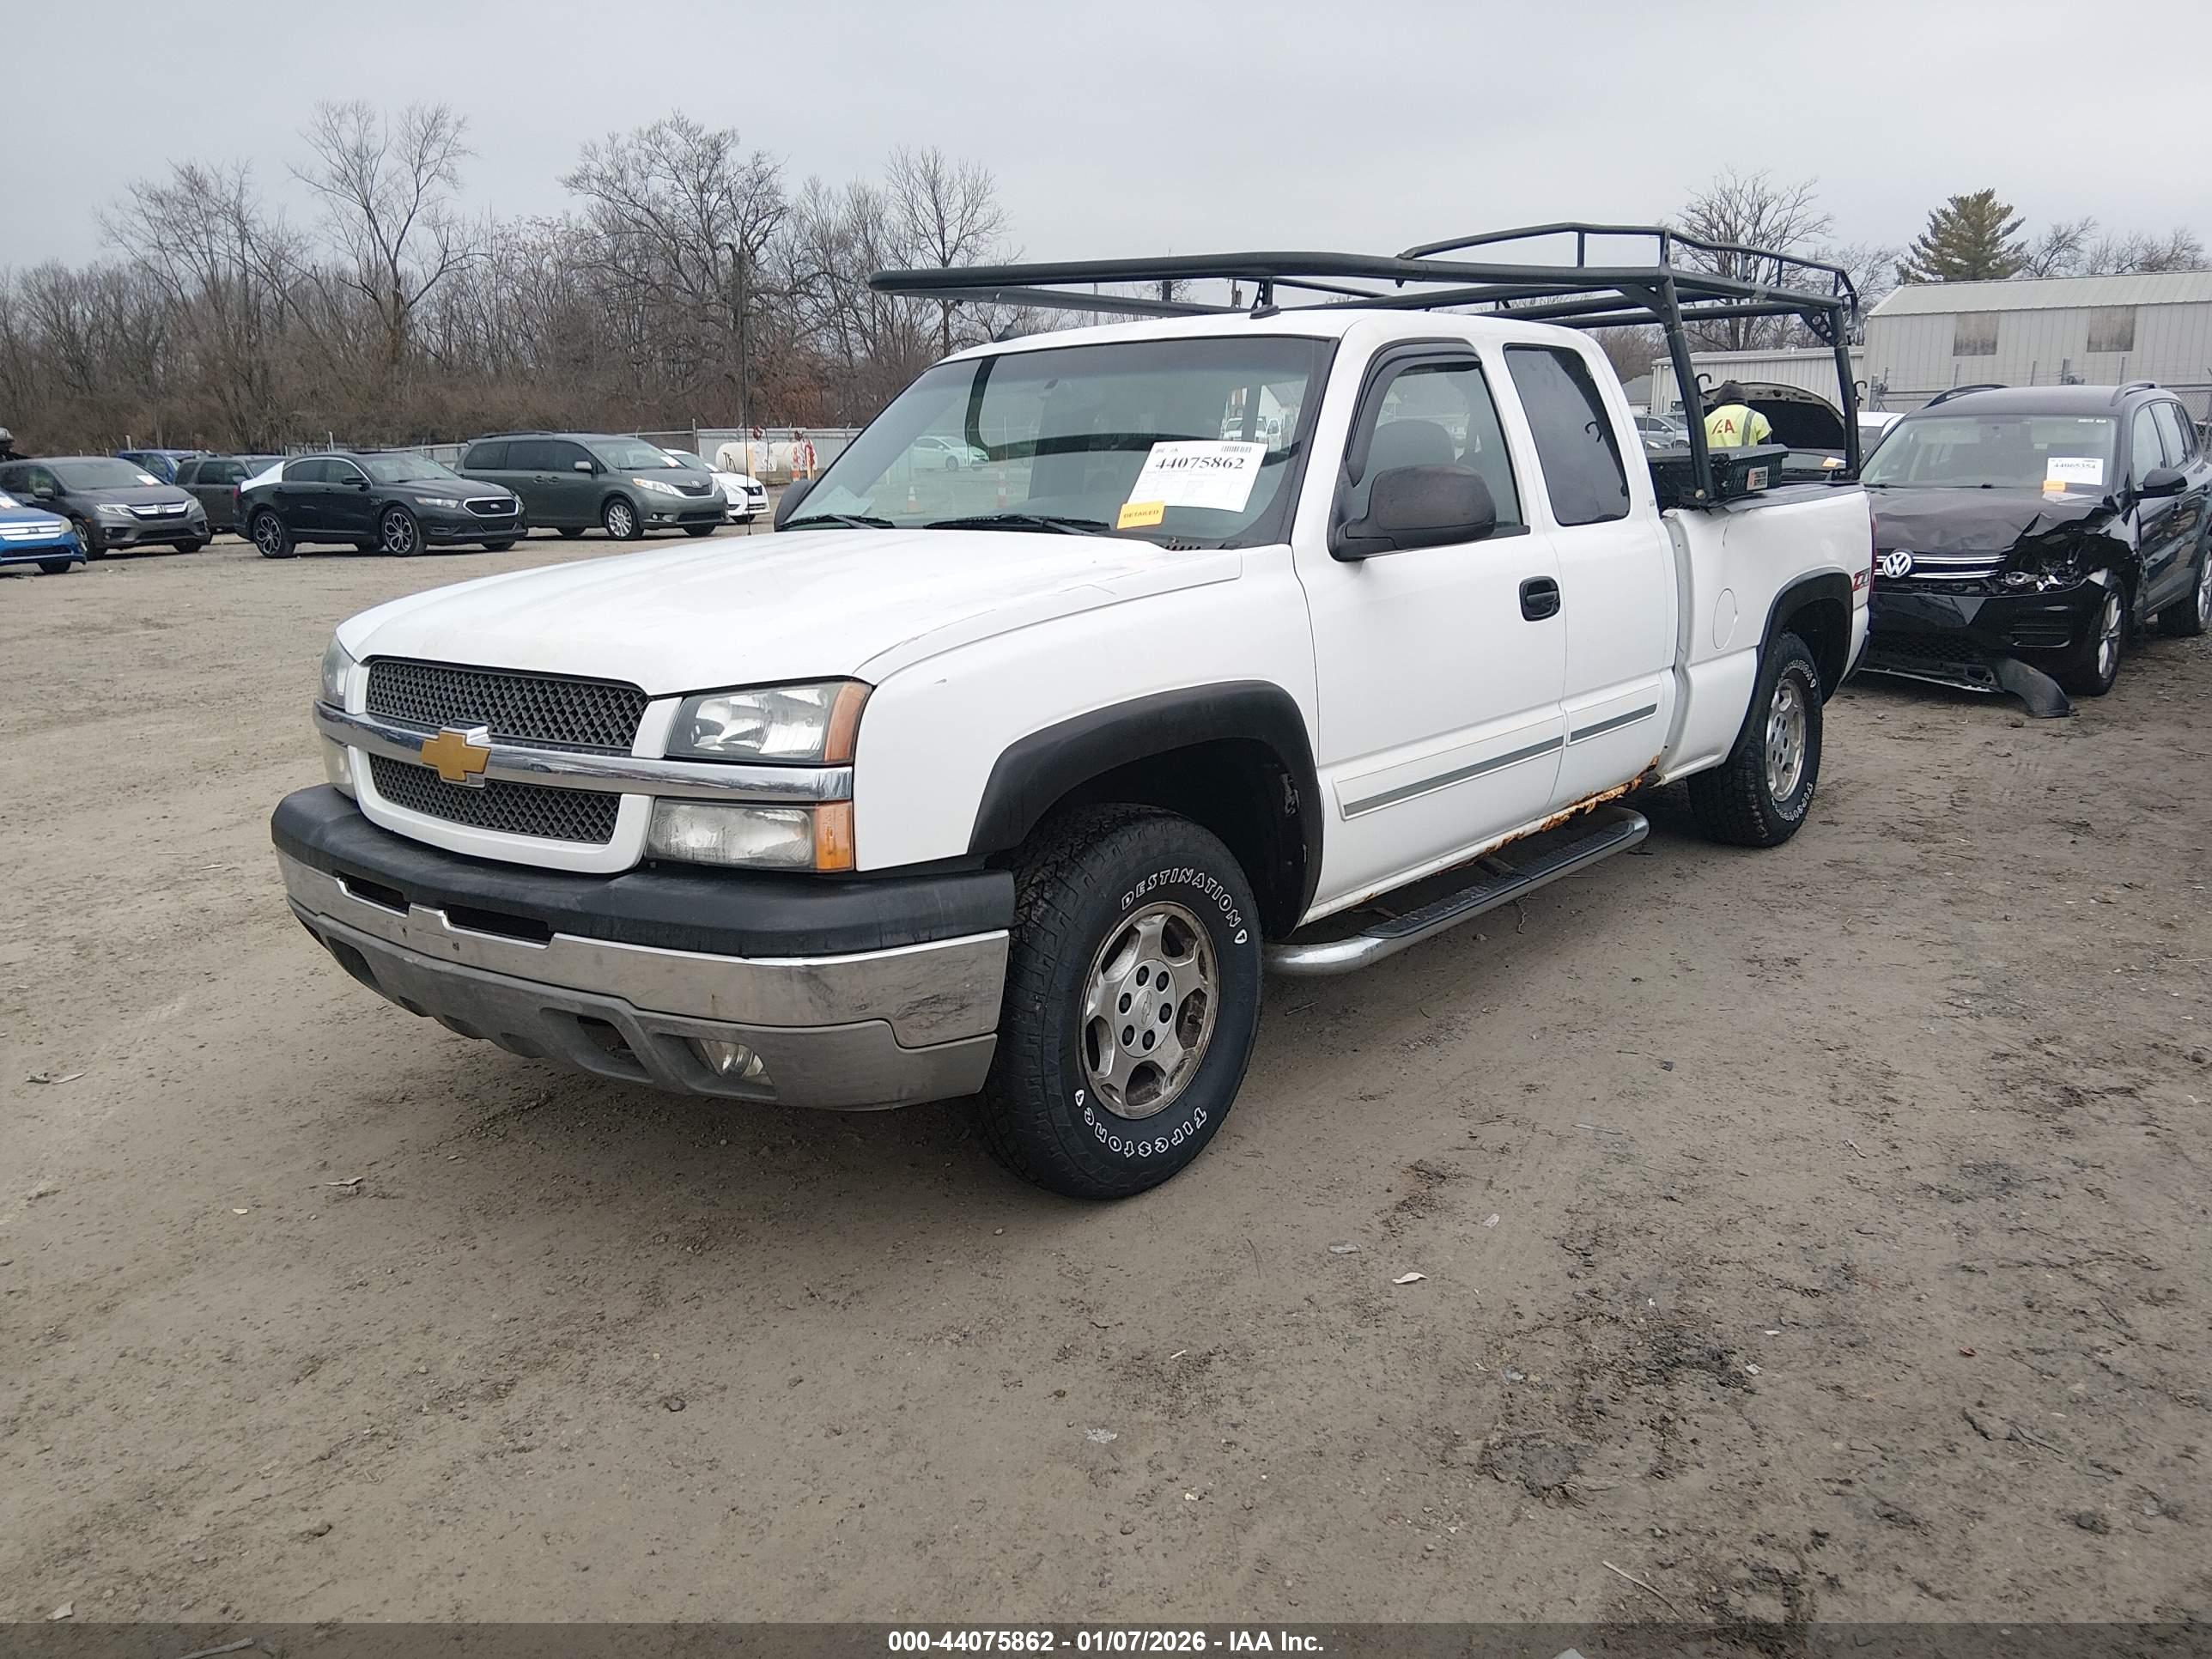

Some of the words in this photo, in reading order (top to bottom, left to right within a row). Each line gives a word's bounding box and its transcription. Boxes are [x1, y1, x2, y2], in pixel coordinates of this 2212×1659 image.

[1155, 457, 1245, 469] 44075862
[1123, 509, 1159, 519] DETAILED
[1121, 867, 1243, 928] DESTINATION
[1084, 1107, 1207, 1158] Firestone
